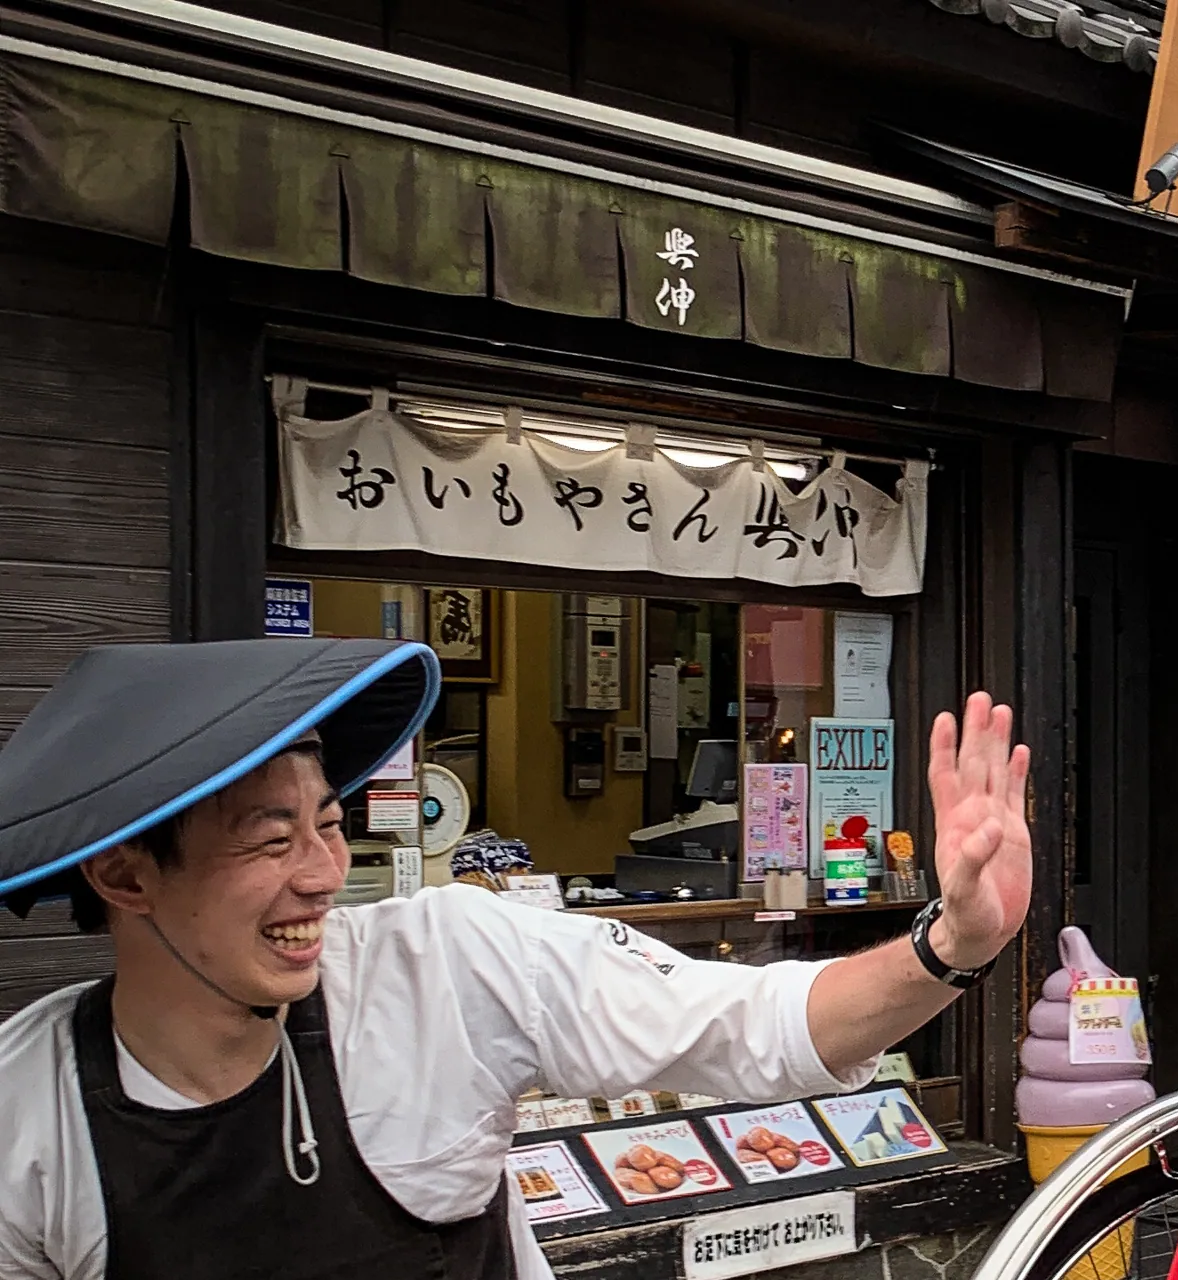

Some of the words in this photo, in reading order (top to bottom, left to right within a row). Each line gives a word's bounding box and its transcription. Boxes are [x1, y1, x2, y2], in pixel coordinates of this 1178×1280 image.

[656, 228, 699, 325] 興伸
[337, 449, 718, 543] おいもやさん
[266, 603, 300, 616] システム
[815, 728, 890, 771] EXILE
